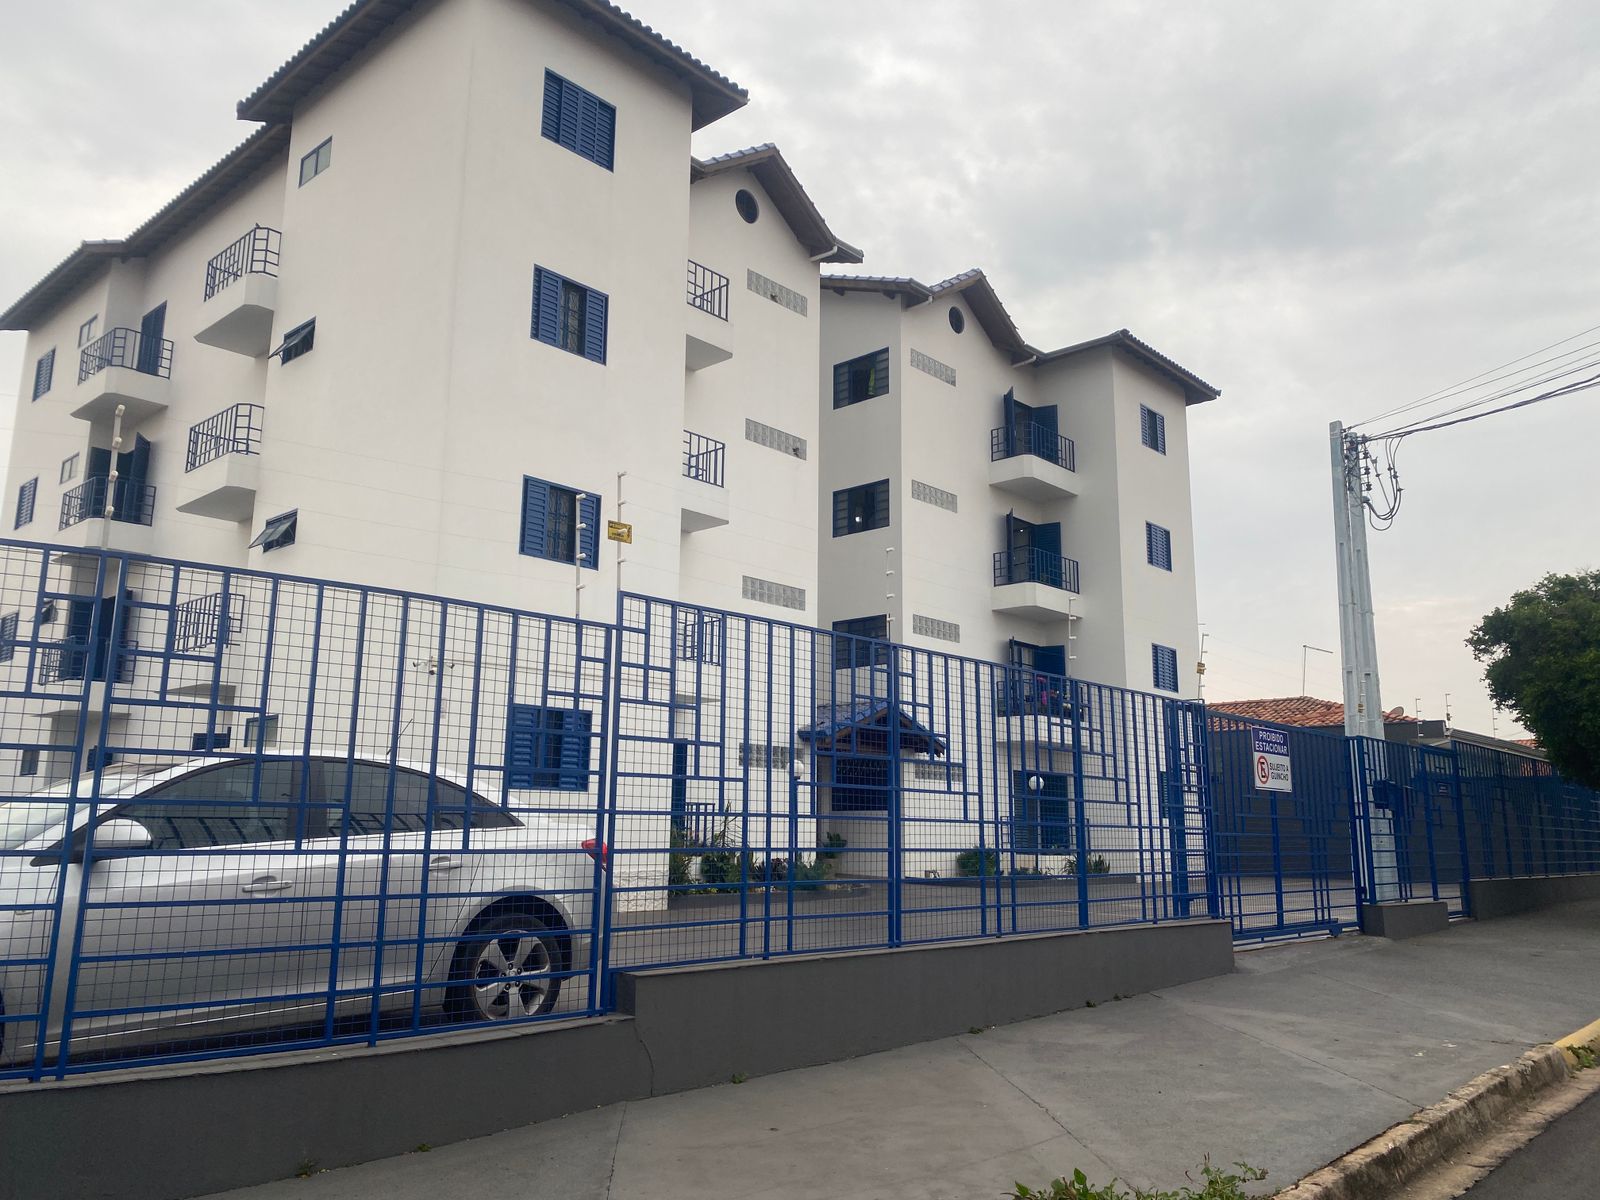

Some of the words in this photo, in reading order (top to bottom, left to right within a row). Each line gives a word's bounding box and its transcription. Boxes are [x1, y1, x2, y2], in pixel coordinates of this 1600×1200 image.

[1259, 731, 1283, 743] PROIBIDO
[1255, 741, 1287, 754] ESTACIONAR
[1271, 772, 1289, 781] GUINCHO
